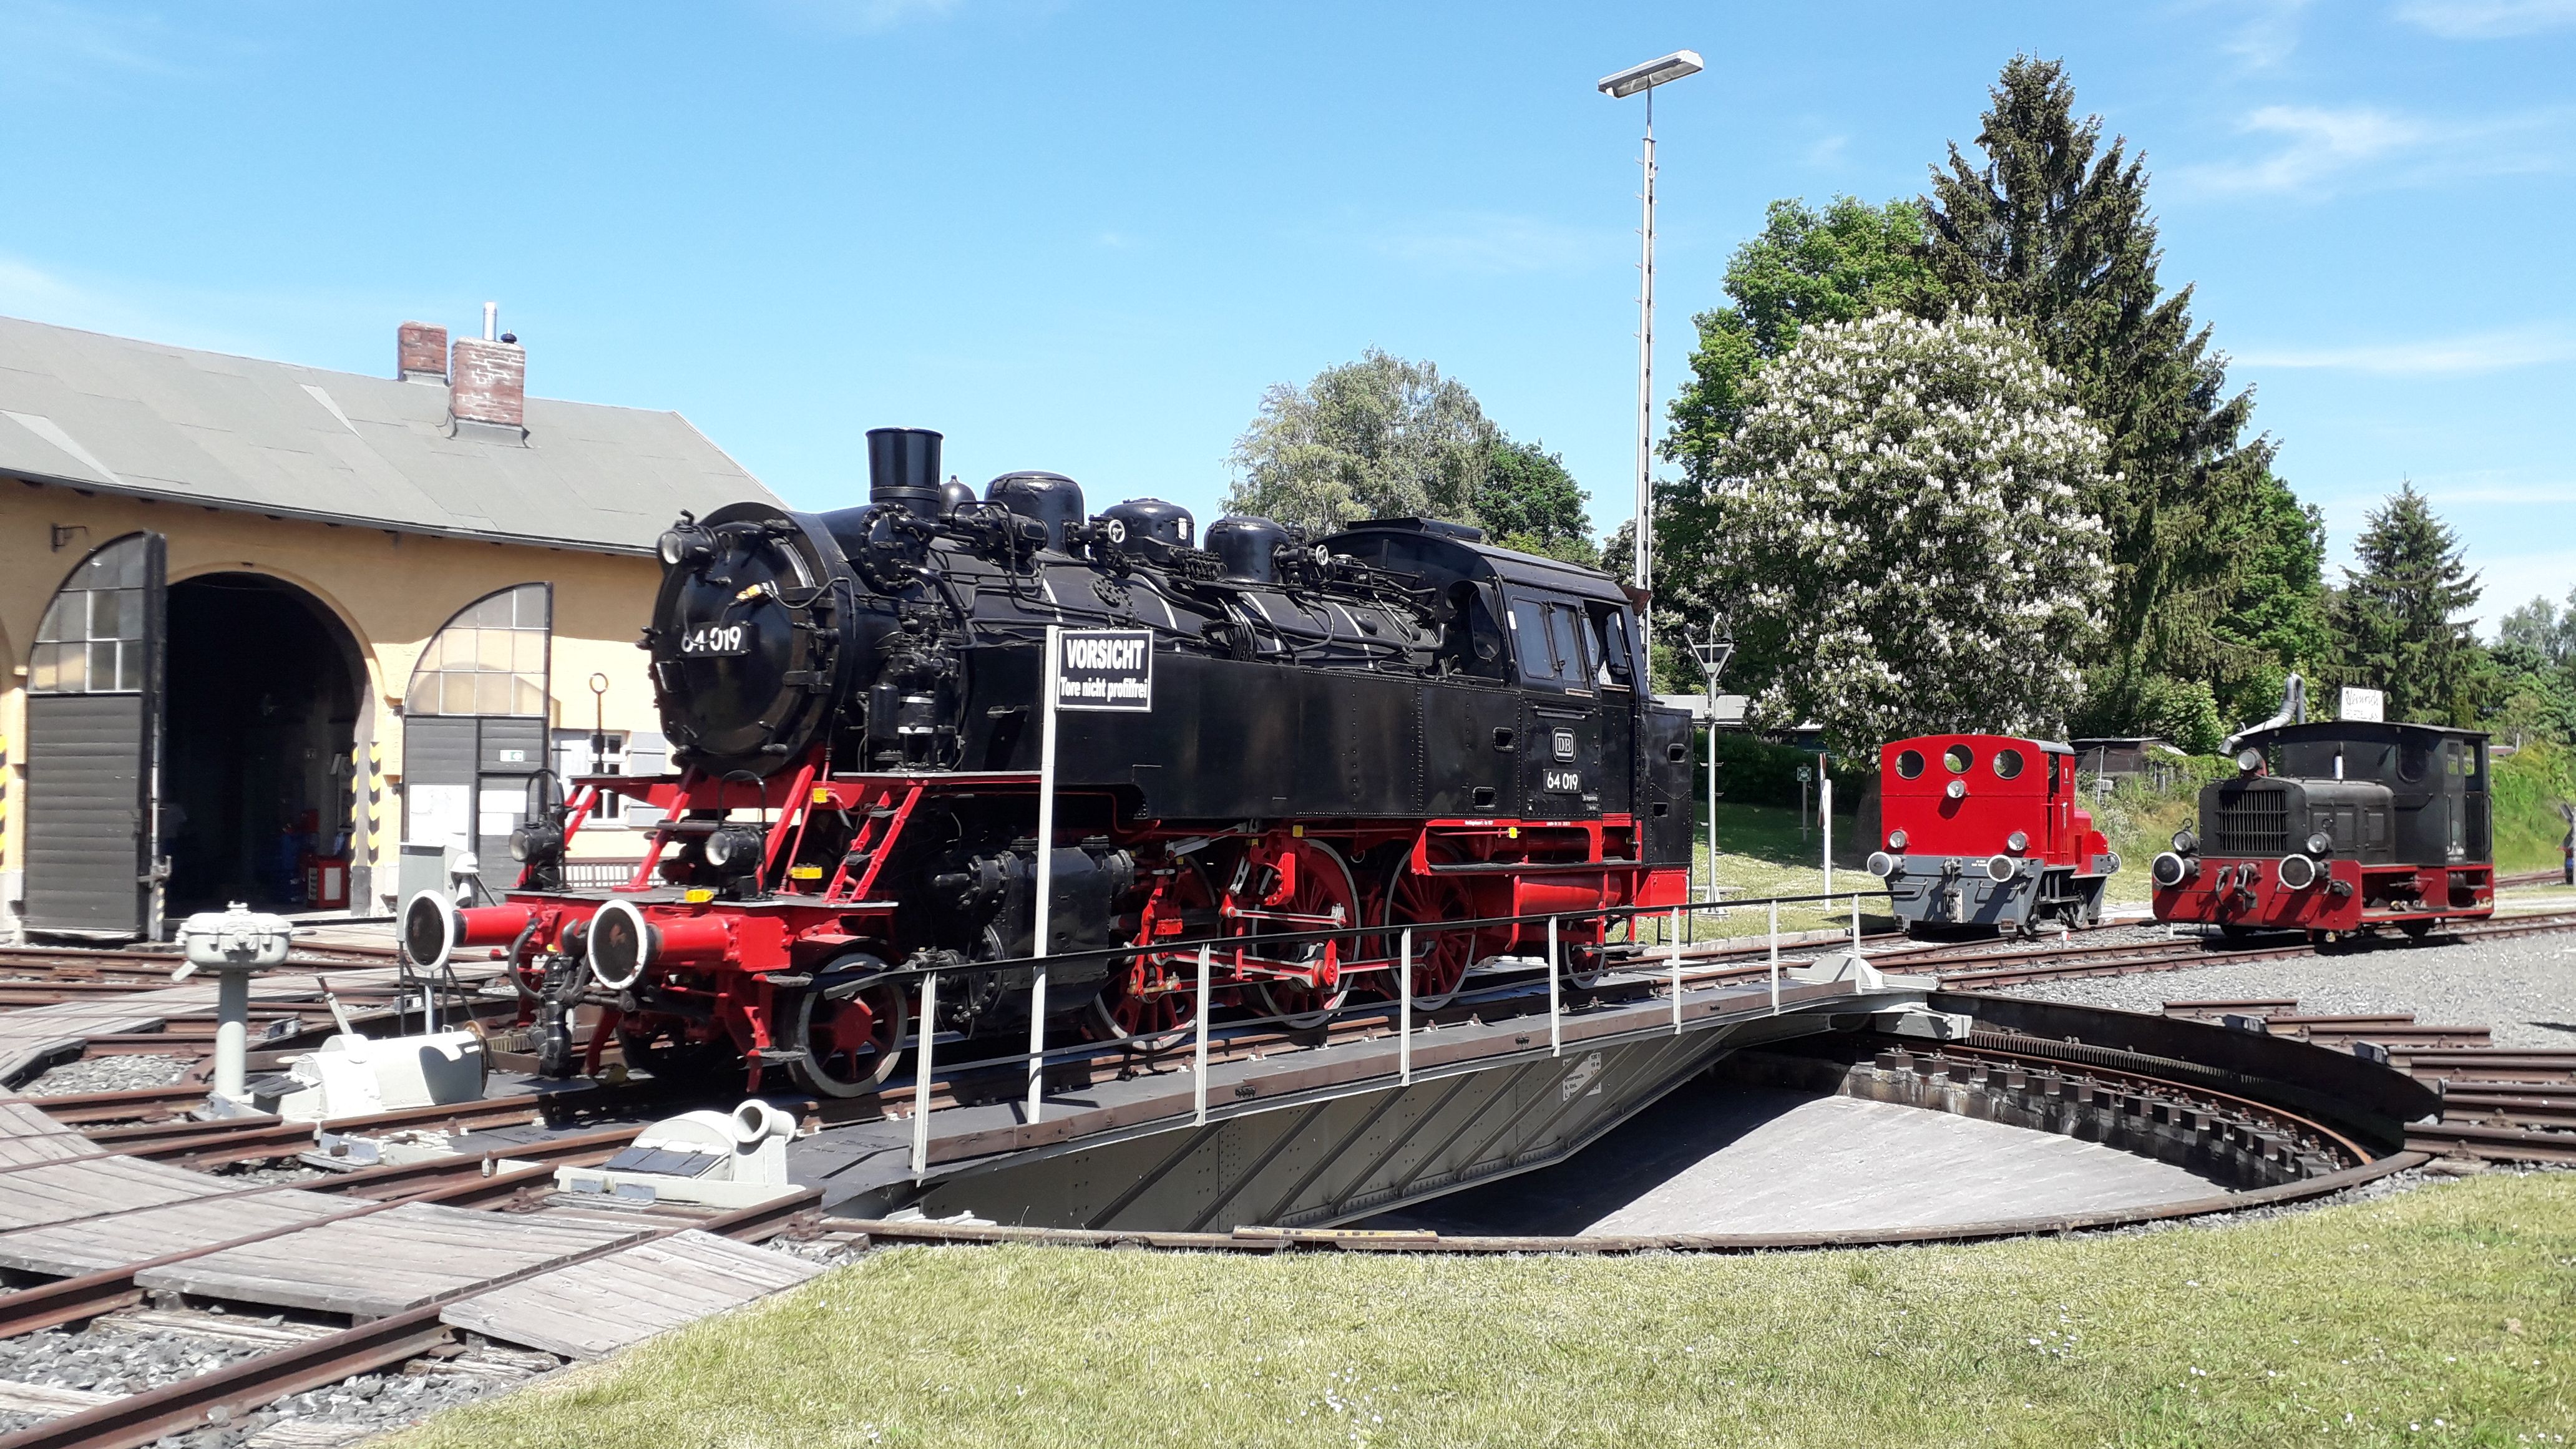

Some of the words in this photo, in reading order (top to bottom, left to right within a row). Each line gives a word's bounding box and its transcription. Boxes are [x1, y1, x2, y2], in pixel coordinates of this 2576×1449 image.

[681, 629, 705, 653] 64
[710, 626, 741, 651] 019
[1066, 639, 1145, 670] VORSICHT
[1061, 676, 1081, 696] Tore
[1082, 678, 1106, 697] nicht
[1107, 678, 1148, 702] profilfrei
[1557, 738, 1571, 752] DB
[1547, 771, 1560, 789] 64
[1562, 773, 1578, 791] 019
